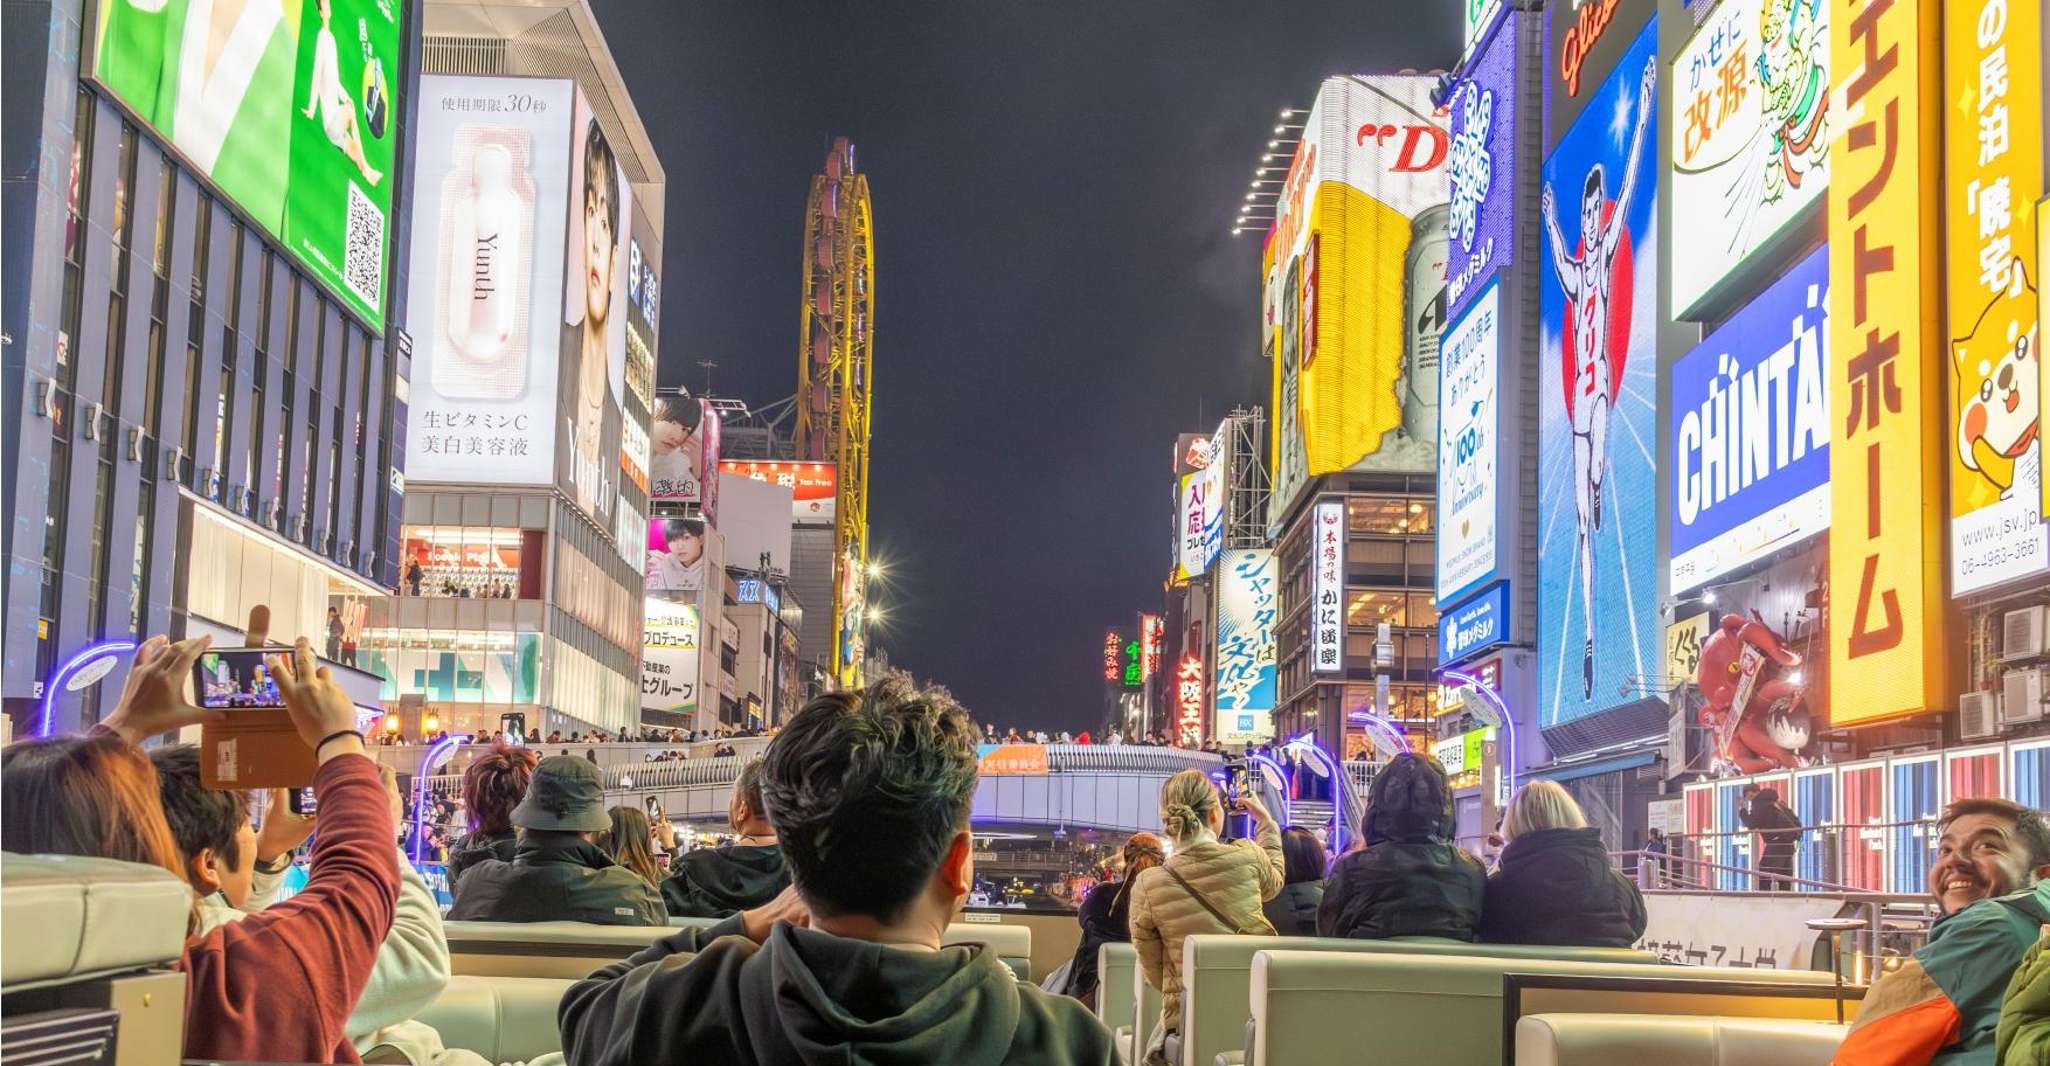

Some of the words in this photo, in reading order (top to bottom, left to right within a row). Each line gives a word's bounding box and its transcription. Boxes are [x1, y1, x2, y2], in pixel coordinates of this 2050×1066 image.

[1690, 10, 1741, 92] かぜに
[1684, 38, 1748, 164] 改源
[474, 233, 498, 300] Yunth
[1584, 286, 1597, 397] グリコ
[1847, 0, 1904, 660] エントホーム
[423, 410, 528, 431] 生ビタミンC
[423, 435, 529, 456] 美白美容液
[567, 416, 609, 517] Yunth
[1961, 538, 2040, 576] 06-4963-3661
[1962, 508, 2038, 547] www.jsv.jp
